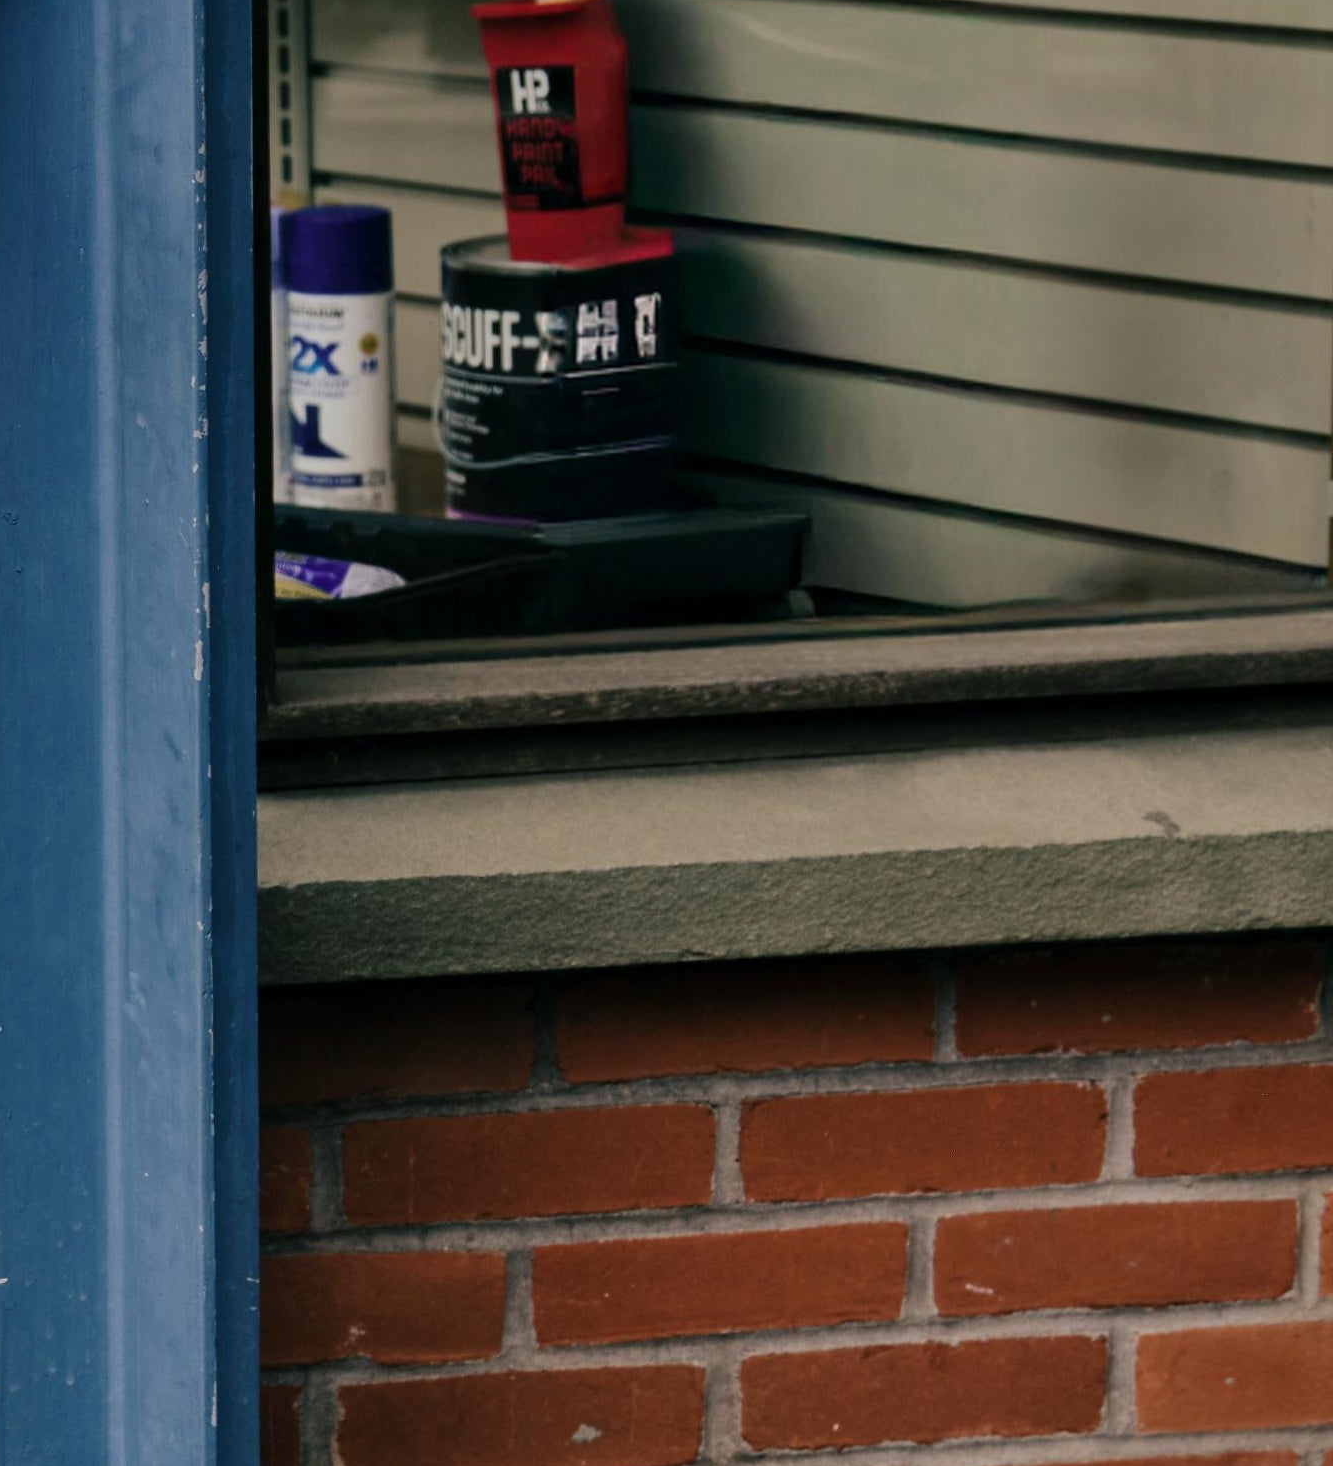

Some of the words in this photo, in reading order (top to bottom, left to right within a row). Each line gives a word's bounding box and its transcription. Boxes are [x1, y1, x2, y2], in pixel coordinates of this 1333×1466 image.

[509, 68, 550, 114] HP
[510, 141, 564, 163] PAINT
[291, 334, 341, 375] 2X
